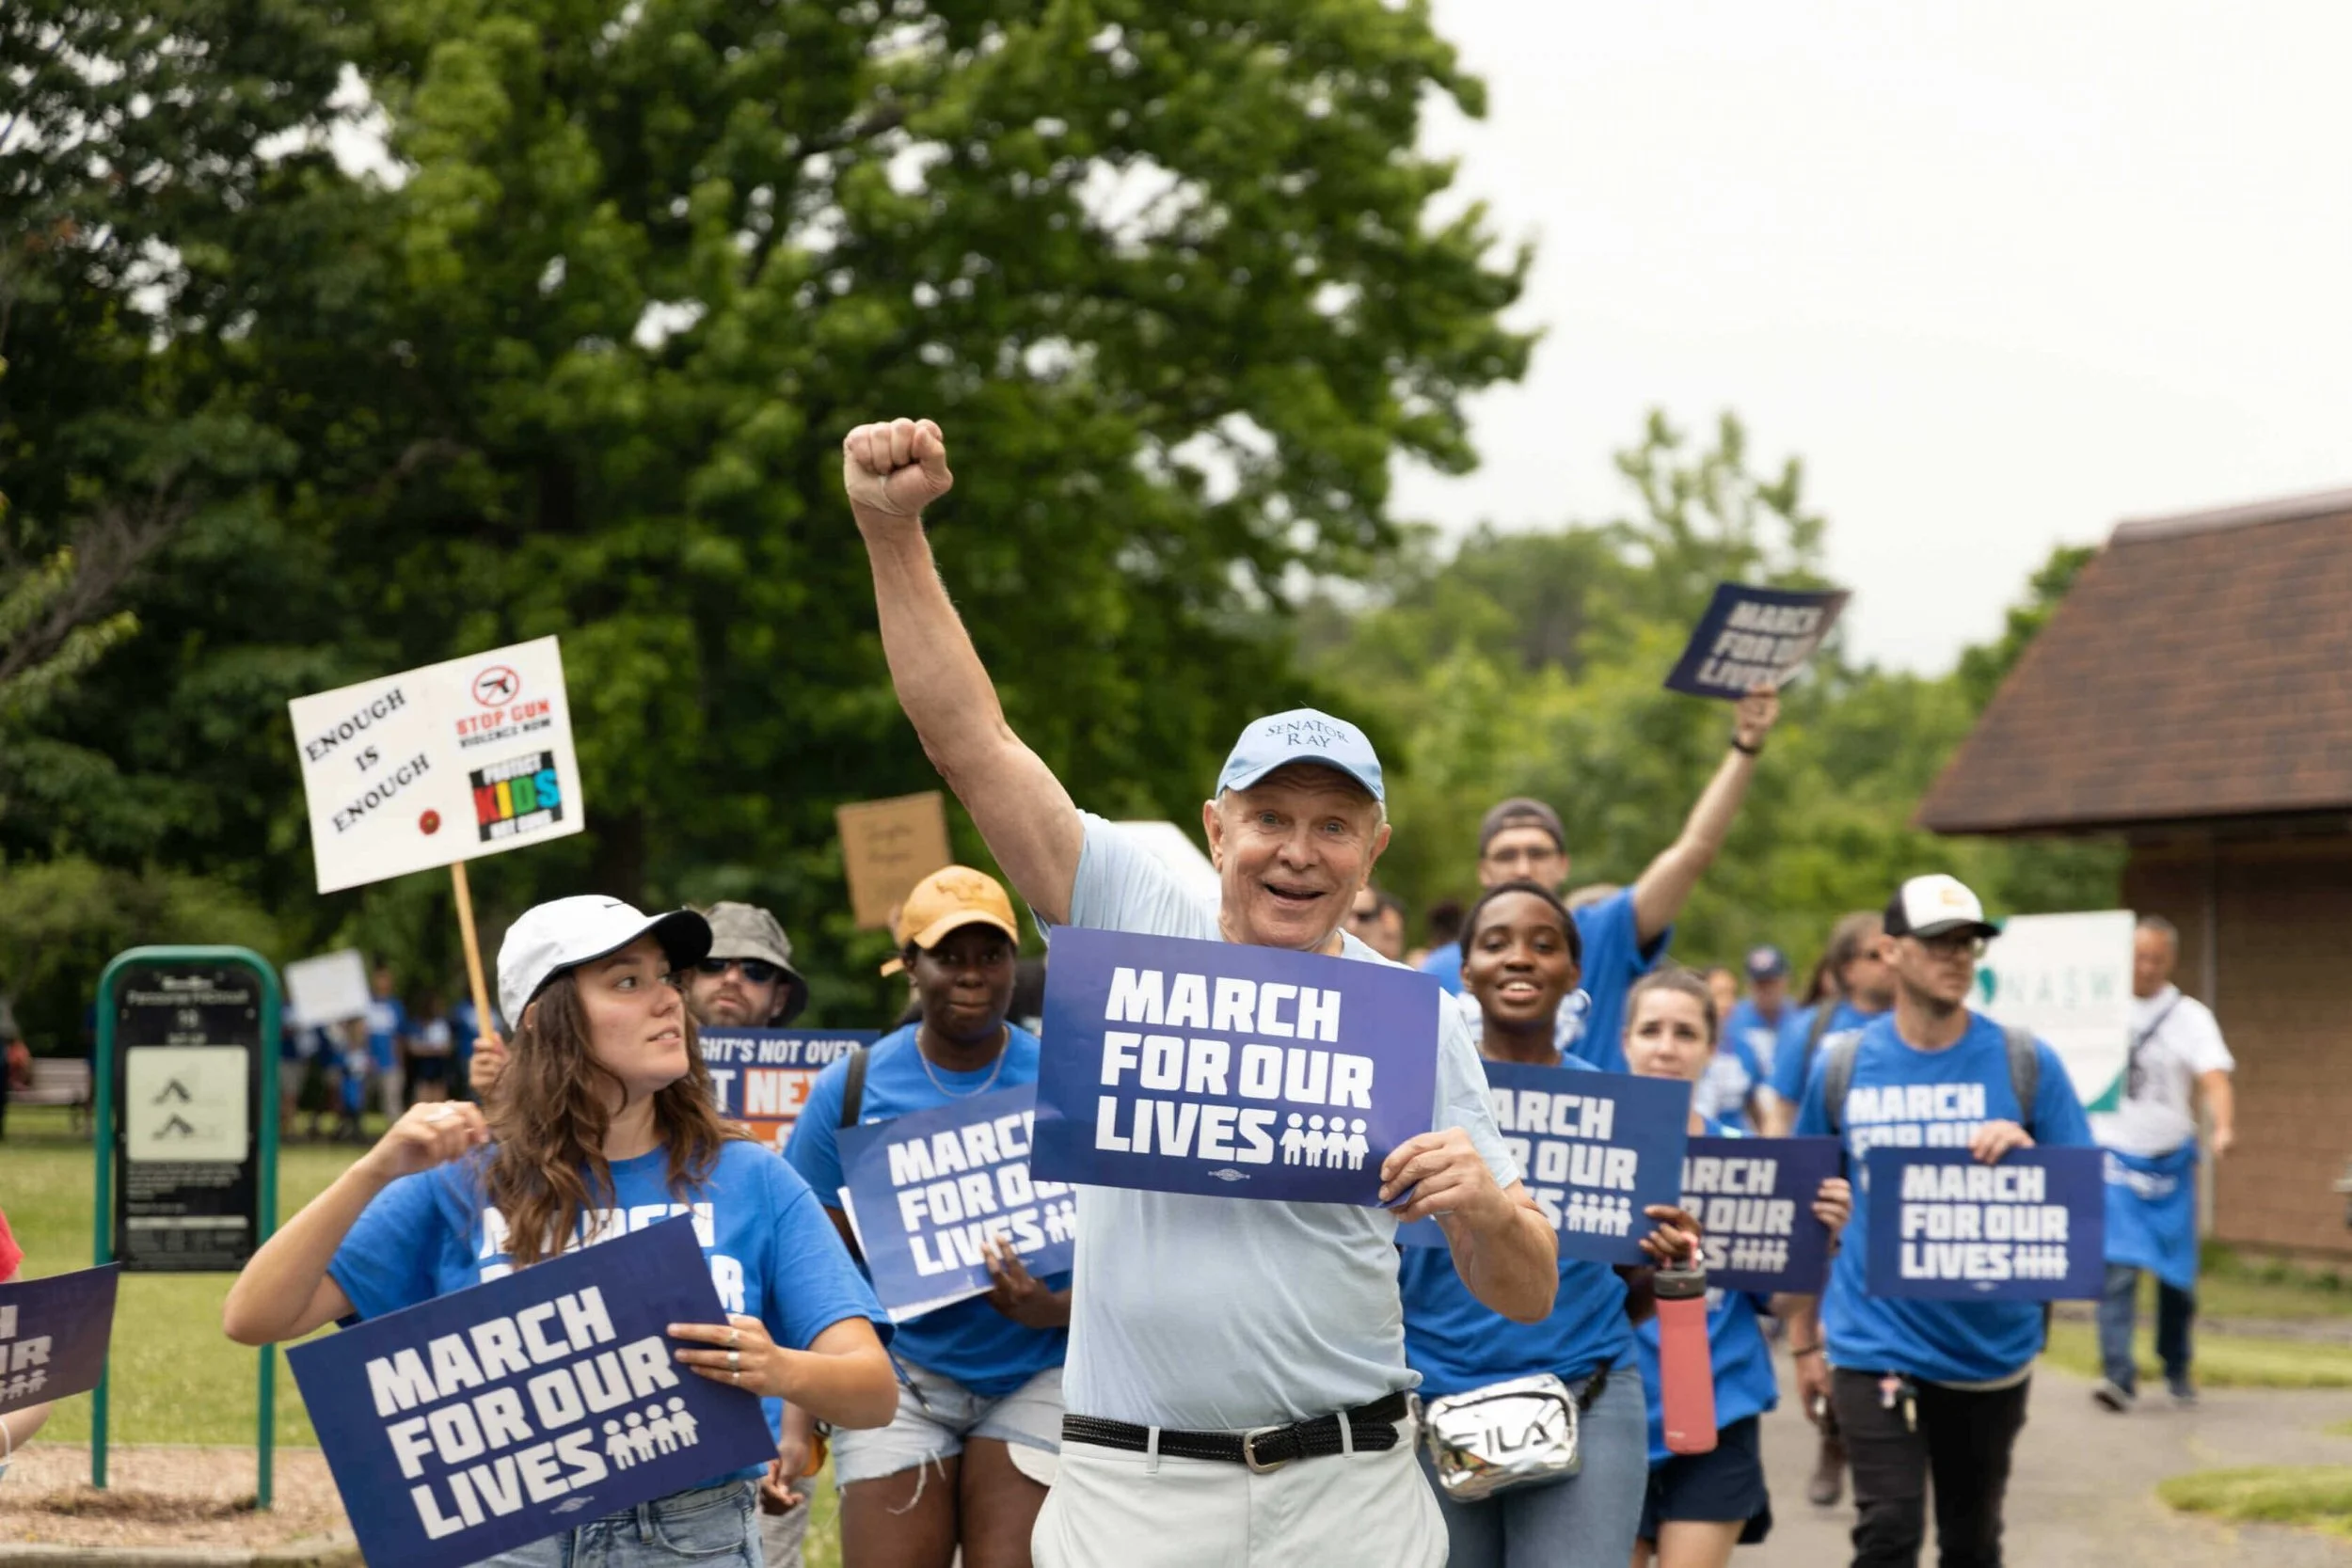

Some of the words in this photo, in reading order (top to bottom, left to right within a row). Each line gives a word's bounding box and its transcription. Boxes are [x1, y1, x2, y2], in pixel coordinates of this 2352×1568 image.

[305, 688, 406, 763] ENOUGH
[456, 711, 505, 736] STOP
[511, 699, 550, 721] GUN
[1265, 719, 1352, 744] SENATOR
[1287, 733, 1331, 749] RAY
[354, 744, 380, 772] IS
[331, 752, 430, 834] ENOUGH
[473, 768, 562, 827] KIDS
[1104, 966, 1342, 1043] MARCH
[699, 1036, 755, 1063] GHT'S
[757, 1038, 803, 1064] NOT
[1100, 1031, 1231, 1096] FOR
[1238, 1043, 1375, 1110] OUR
[1095, 1095, 1278, 1164] LIVES
[1490, 1087, 1615, 1141] ARCH
[1846, 1083, 1986, 1124] MARCH
[1535, 1140, 1638, 1192] OUR
[1681, 1156, 1777, 1196] RCH
[1901, 1164, 2046, 1203] MARCH
[897, 1172, 998, 1233] FOR
[1706, 1196, 1796, 1237] OUR
[1900, 1203, 1981, 1242] FOR
[1983, 1204, 2069, 1243] OUR
[908, 1208, 1046, 1277] LIVES
[1899, 1242, 2012, 1280] LIVES
[364, 1285, 617, 1419] MARCH
[385, 1386, 534, 1481] FOR
[526, 1335, 680, 1431] OUR
[1450, 1420, 1551, 1456] FILA
[410, 1428, 610, 1541] LIVES
